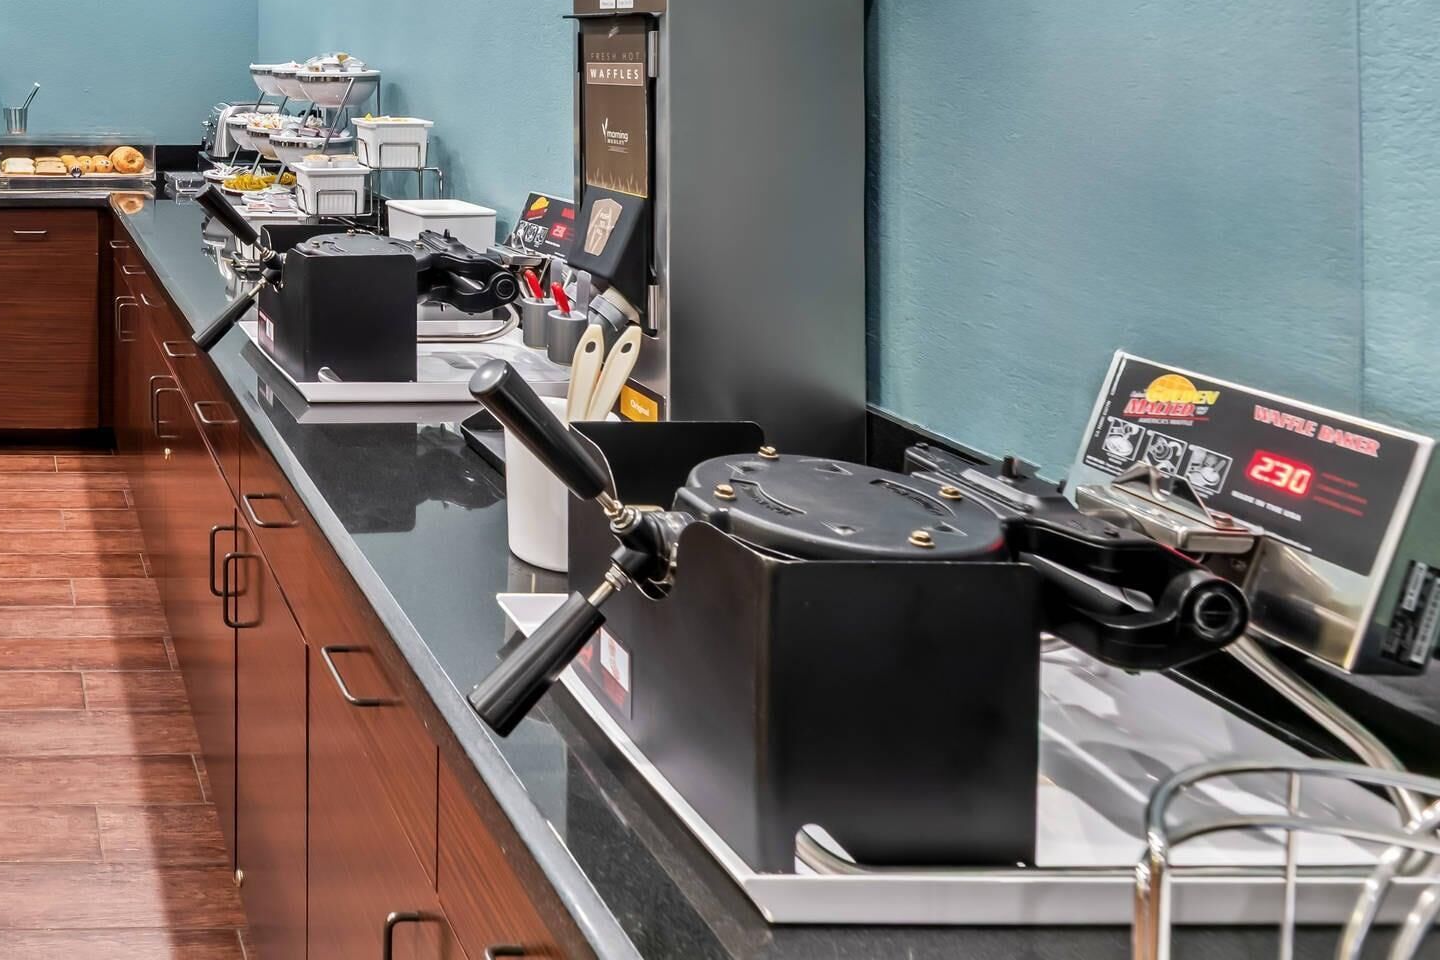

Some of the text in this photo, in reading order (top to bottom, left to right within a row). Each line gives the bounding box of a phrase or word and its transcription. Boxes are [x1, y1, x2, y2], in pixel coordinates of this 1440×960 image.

[590, 51, 641, 61] FRESH HOT
[589, 68, 640, 80] WAFFLES
[1123, 398, 1196, 417] MALTED
[1254, 404, 1381, 458] WAFFLE BAKER
[1250, 456, 1312, 495] 230
